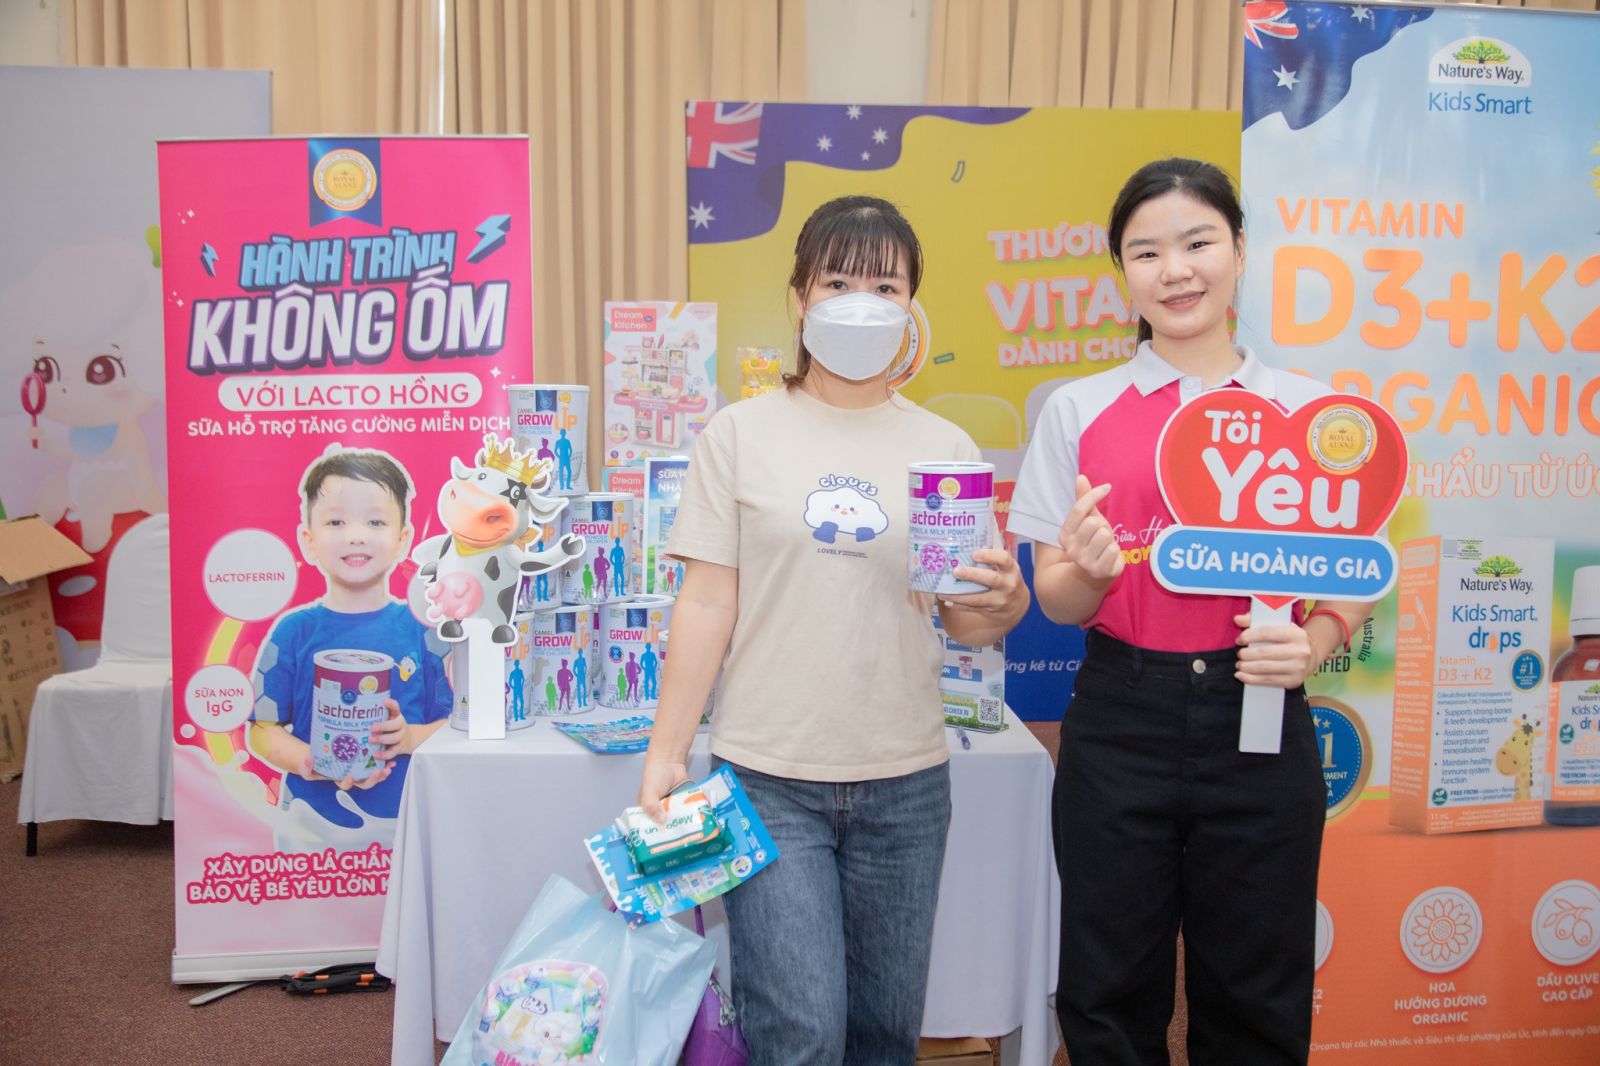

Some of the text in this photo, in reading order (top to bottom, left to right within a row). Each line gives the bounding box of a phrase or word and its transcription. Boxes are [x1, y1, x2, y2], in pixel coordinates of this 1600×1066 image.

[1438, 63, 1491, 79] Nature's
[1428, 91, 1532, 114] Kids Smart
[1276, 196, 1465, 238] VITAMIN
[239, 228, 457, 290] HÀNH TRÌNH
[986, 275, 1139, 332] VITA
[189, 265, 508, 371] KHÔNG ỐM
[614, 311, 643, 319] Dream
[614, 321, 647, 330] Kitchen
[1000, 337, 1078, 367] DÀNH
[236, 377, 469, 407] VỚI LACTO HỒNG
[1287, 368, 1600, 436] RGANI
[188, 418, 223, 437] SỮA
[228, 413, 256, 436] HỖ
[259, 419, 296, 438] TRỢ
[299, 417, 347, 434] TĂNG
[352, 414, 416, 433] CƯỜNG
[421, 410, 462, 432] MIỄN
[470, 415, 511, 435] DỊCH
[518, 414, 553, 426] GROW
[1204, 410, 1262, 445] Tôi
[612, 476, 641, 485] Dream
[1508, 452, 1561, 498] TỪ
[1566, 453, 1600, 498] Ú
[819, 474, 878, 497] clouds
[1201, 447, 1360, 529] Yêu
[910, 511, 976, 527] actoferrin
[571, 523, 609, 535] GROW
[1139, 515, 1164, 544] H
[1168, 543, 1224, 573] SỮA
[1230, 545, 1330, 577] HOÀNG
[1335, 557, 1382, 580] GIA
[209, 572, 285, 583] LACTOFERRIN
[1460, 578, 1507, 591] Nature's
[1452, 604, 1535, 622] Kids Smart
[534, 636, 572, 647] GROW
[609, 629, 643, 640] GROW
[1357, 617, 1374, 663] Australia
[1029, 660, 1046, 671] kê
[1048, 660, 1062, 671] từ
[1318, 656, 1350, 673] IFIED
[1439, 656, 1476, 665] Vitamin
[1520, 662, 1534, 675] #1
[1438, 669, 1458, 681] D3
[1474, 668, 1492, 680] K2
[194, 687, 244, 698] SỮA NON
[206, 700, 233, 716] IgG
[317, 700, 384, 719] Lactoferrin
[1444, 709, 1472, 717] Supports
[1571, 705, 1591, 716] Kids
[1467, 716, 1507, 725] development
[1443, 738, 1476, 746] absorption
[1470, 758, 1492, 766] healthy
[1469, 768, 1490, 776] system
[207, 856, 246, 876] XÂY
[251, 856, 308, 879] DỰNG
[313, 851, 338, 872] LÁ
[189, 879, 231, 900] BẢO
[235, 879, 260, 903] VỆ
[266, 877, 289, 897] BÉ
[293, 877, 331, 896] YÊU
[336, 874, 375, 894] LỚN
[1537, 972, 1599, 986] DẦU OLIVE
[1429, 982, 1456, 993] HOA
[1542, 986, 1593, 1002] CAO CẤP
[1394, 992, 1487, 1011] HƯỚNG DƯƠNG
[1412, 1011, 1469, 1025] ORGANIC
[1310, 1042, 1339, 1051] Circana
[1370, 1038, 1387, 1047] Nhà
